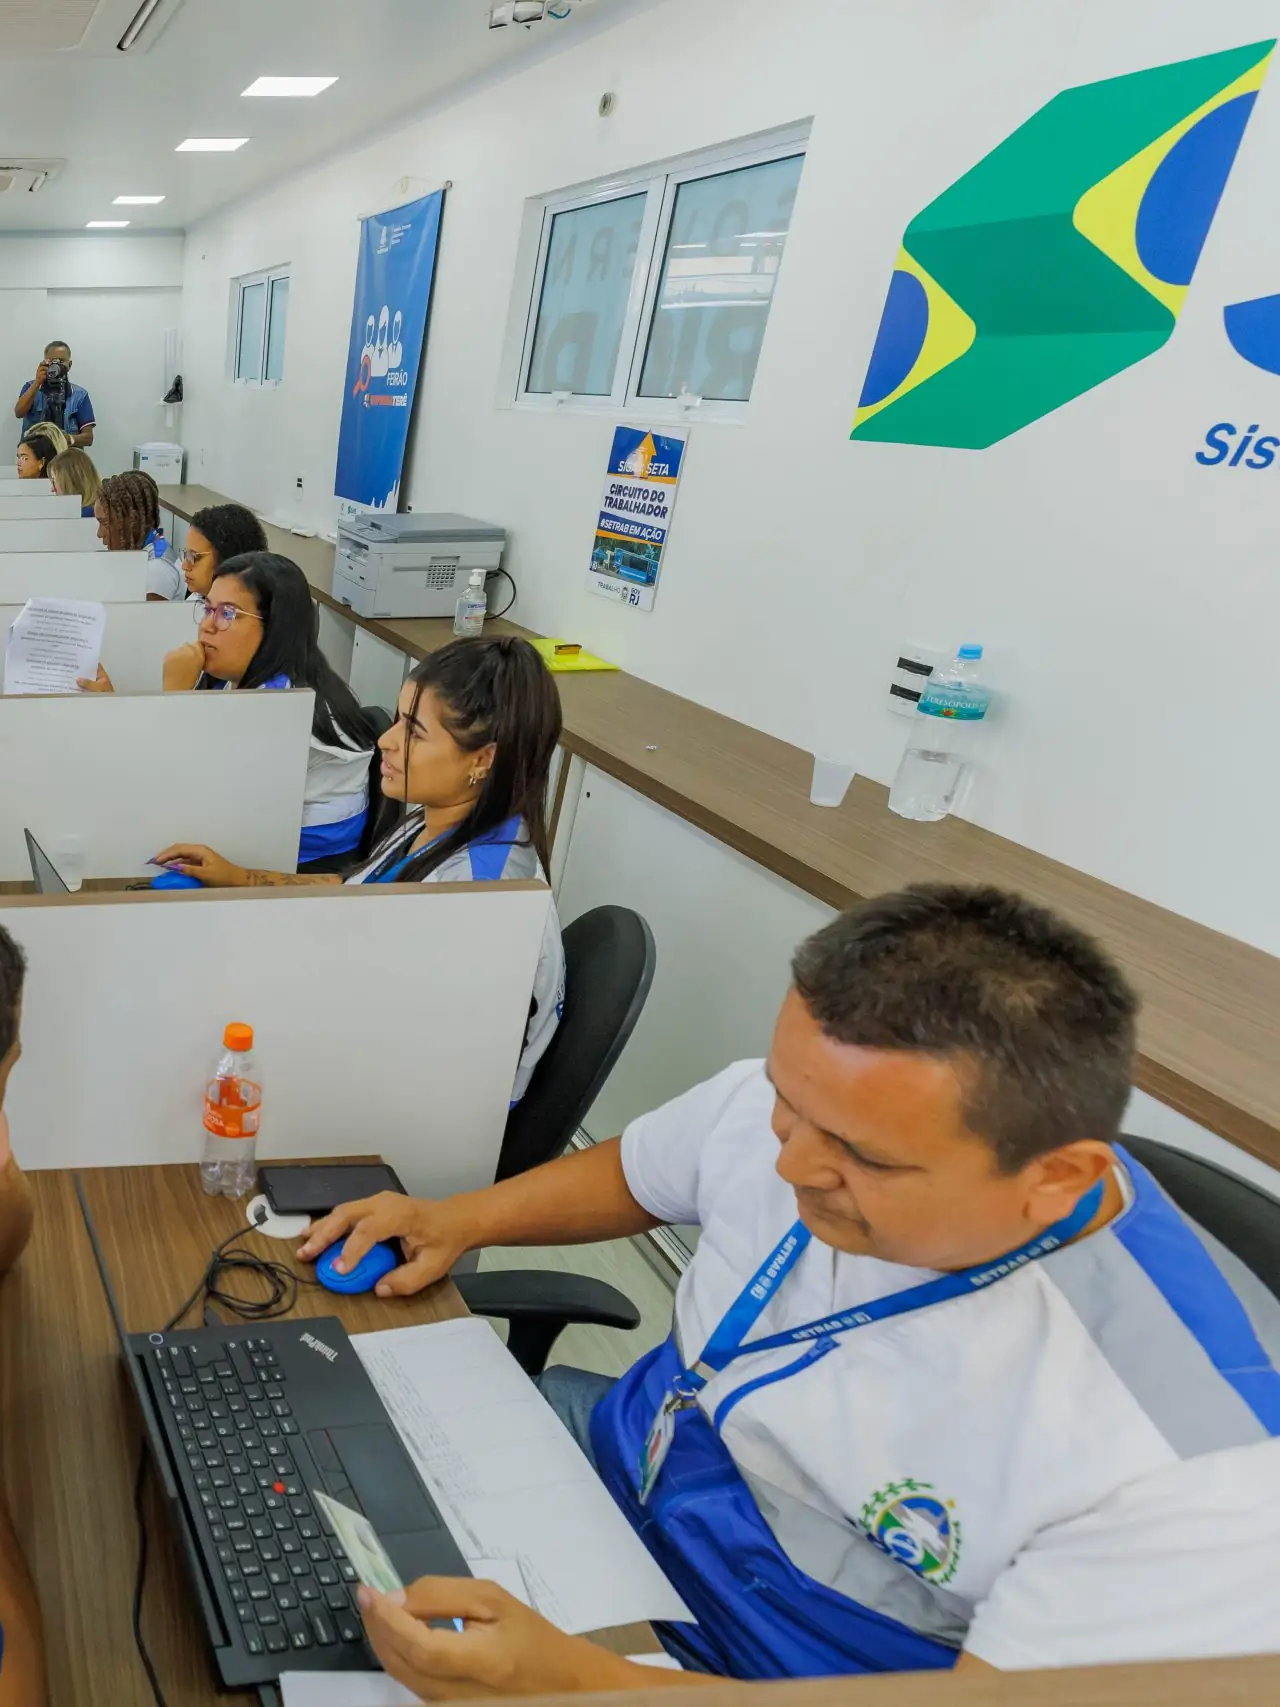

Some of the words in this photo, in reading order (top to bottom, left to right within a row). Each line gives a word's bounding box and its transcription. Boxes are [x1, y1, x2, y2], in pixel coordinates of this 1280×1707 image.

[1195, 422, 1280, 470] Sis
[646, 462, 669, 476] SETA
[609, 483, 649, 501] CIRCUITO
[650, 489, 666, 503] DO
[604, 495, 669, 519] TRABALHADOR
[600, 518, 629, 533] #SETRAB
[629, 525, 640, 536] EM
[640, 527, 663, 541] AÇÃO
[628, 593, 640, 606] RJ
[767, 1233, 799, 1281] SETRAB
[299, 1332, 339, 1363] ThinkPad
